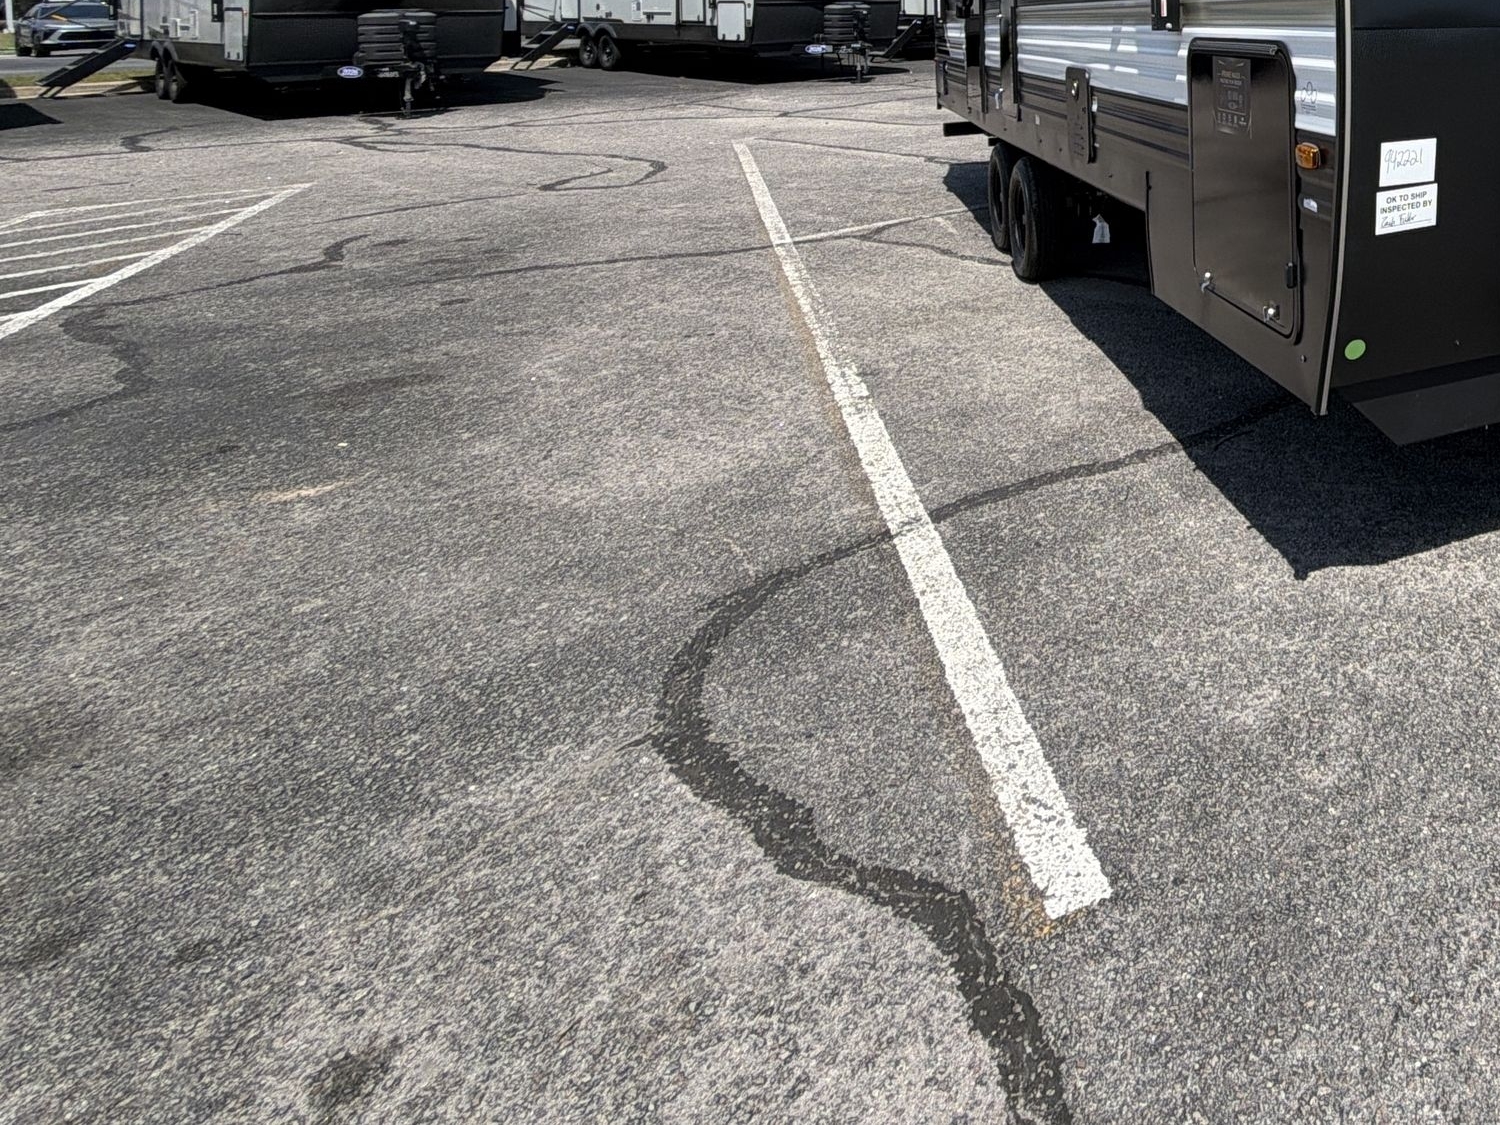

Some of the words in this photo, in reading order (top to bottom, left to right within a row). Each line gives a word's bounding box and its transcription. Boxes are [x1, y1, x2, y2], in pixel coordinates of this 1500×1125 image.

[1386, 196, 1397, 204] OK
[1399, 194, 1409, 202] TO
[1410, 191, 1428, 200] SHIP
[1380, 201, 1421, 214] INSPECTED
[1422, 199, 1432, 207] BY
